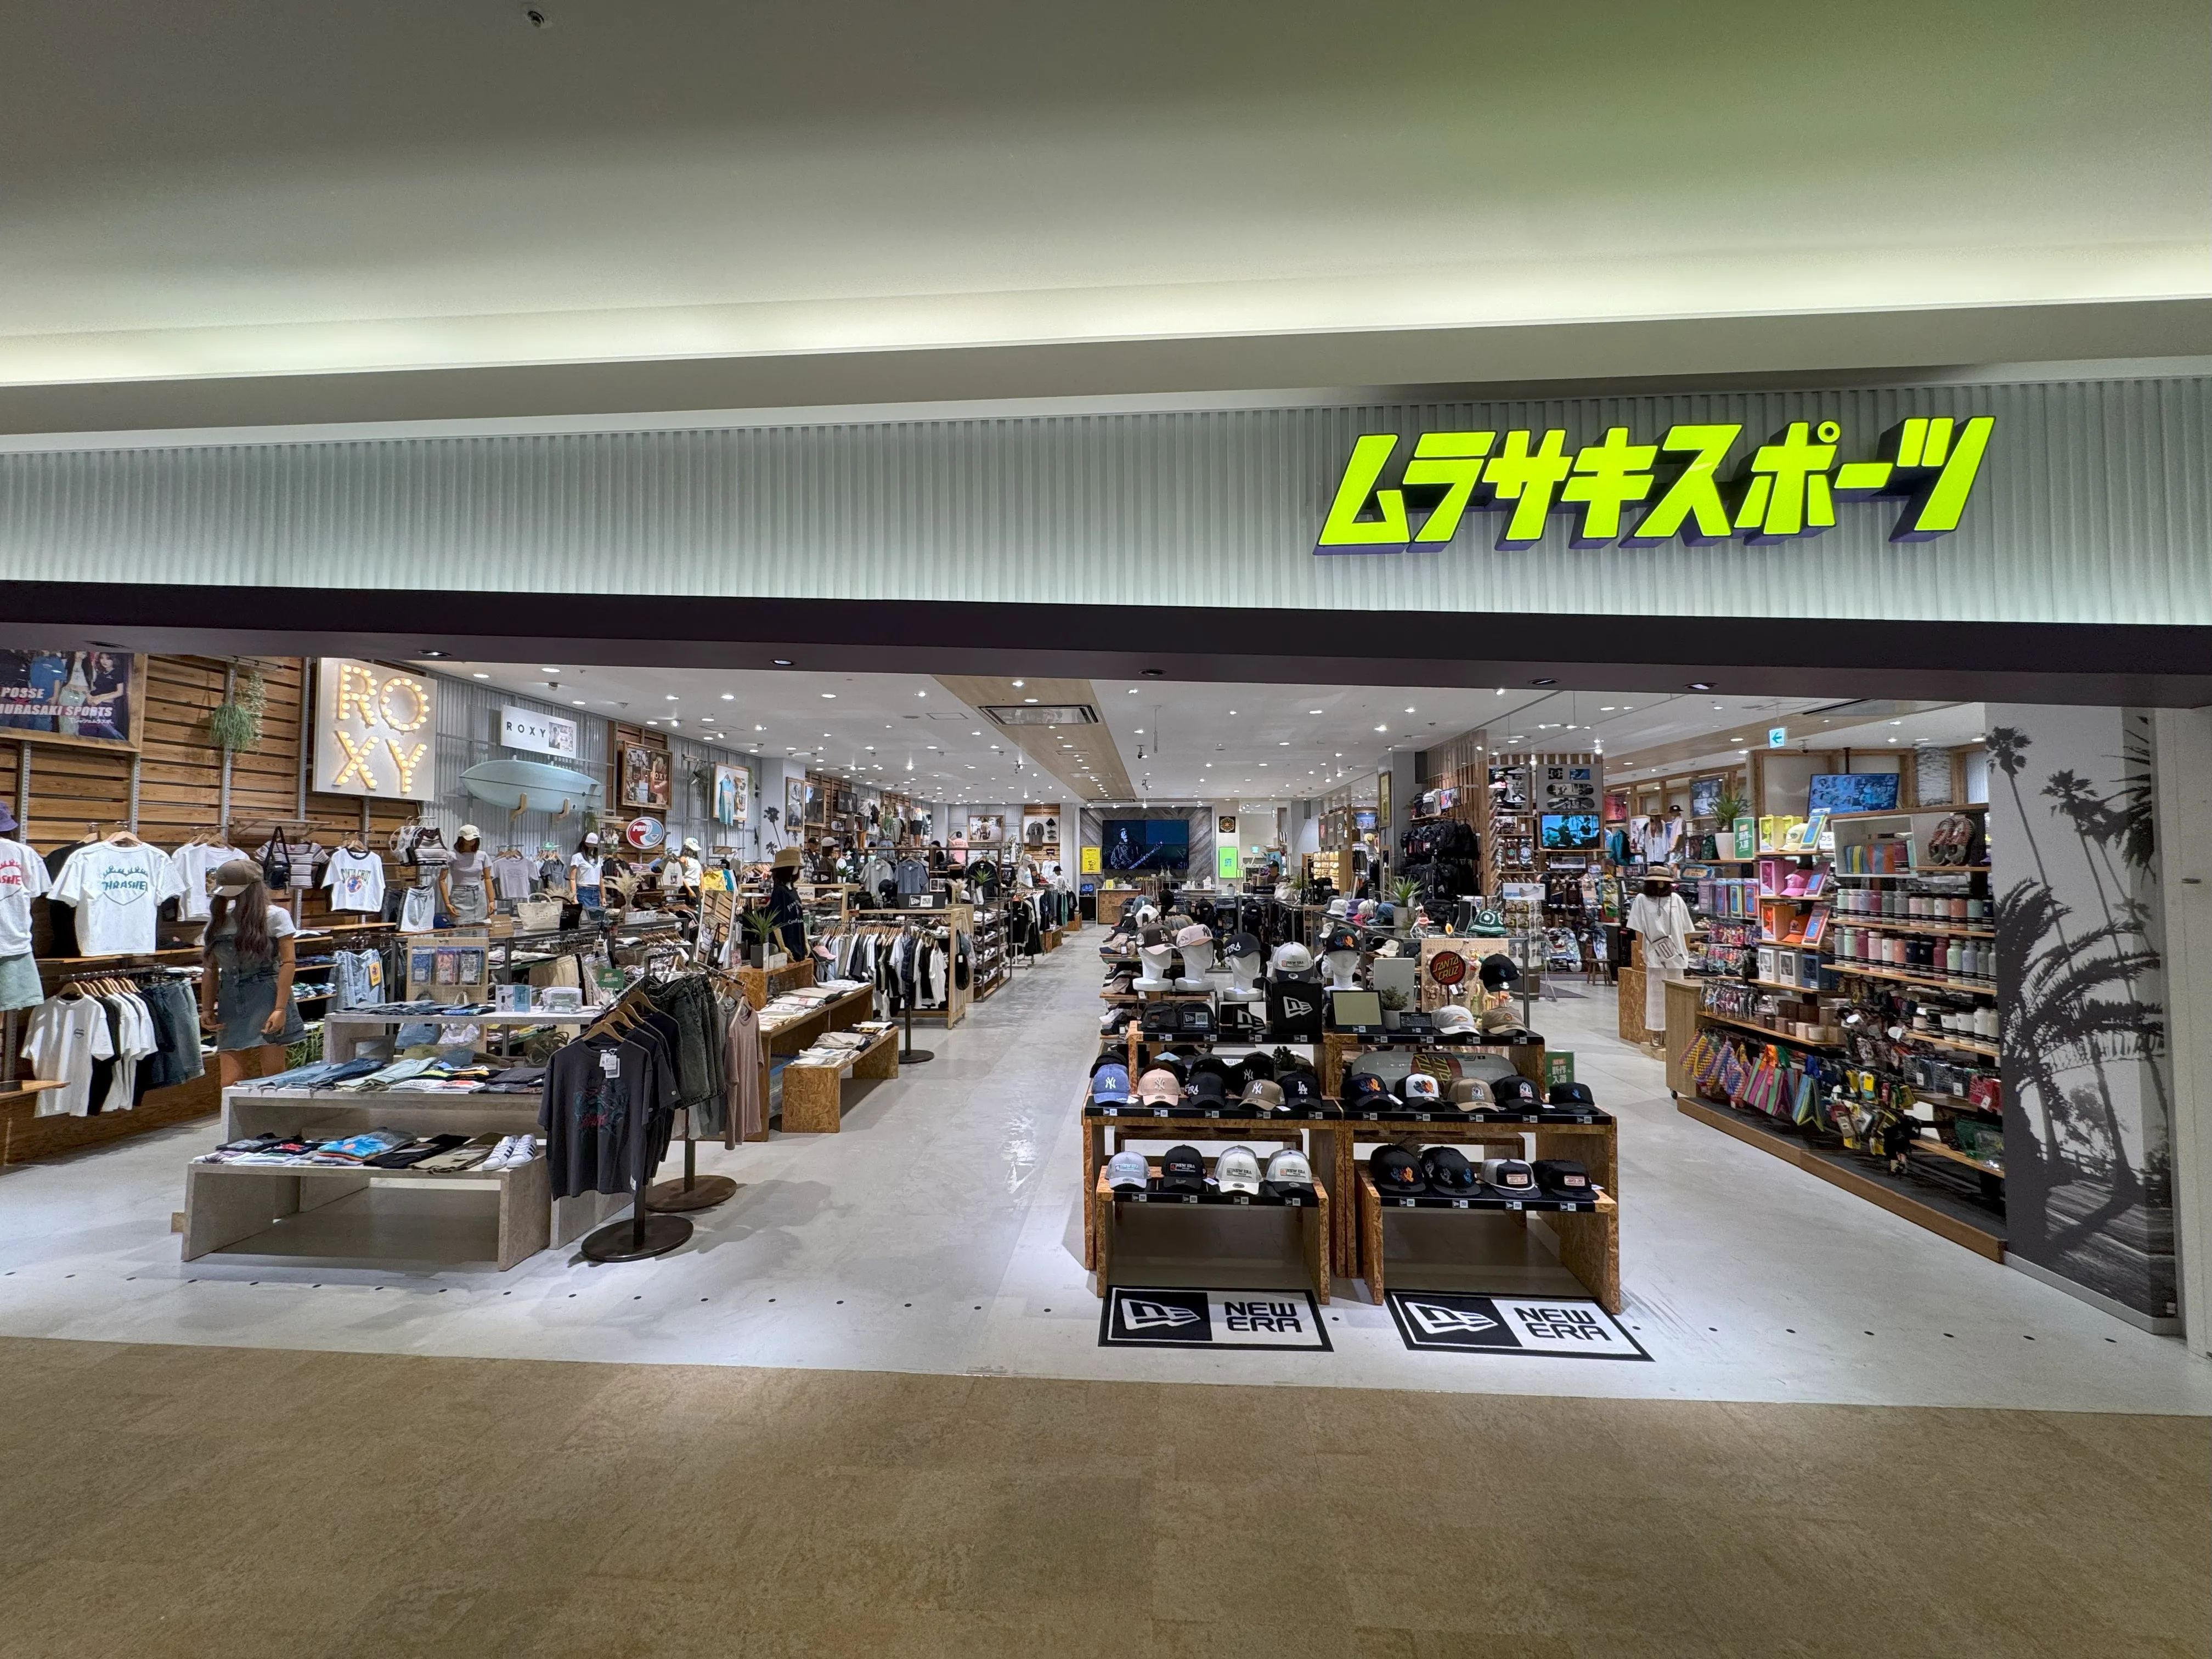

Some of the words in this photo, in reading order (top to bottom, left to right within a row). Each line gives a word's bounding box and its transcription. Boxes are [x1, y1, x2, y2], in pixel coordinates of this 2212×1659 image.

[1318, 415, 1996, 546] ムラサキスポーツ
[1, 687, 45, 698] POSSE
[65, 706, 113, 716] SPORTS
[506, 721, 546, 737] ROXY
[1159, 930, 1169, 941] LA
[1432, 955, 1459, 973] SANTA
[1438, 966, 1459, 981] CRUZ
[1105, 1076, 1116, 1089] NY
[1252, 1082, 1263, 1094] NY
[1297, 1081, 1308, 1094] LA
[1224, 1301, 1297, 1317] NEW
[1514, 1307, 1596, 1324] NEW
[1227, 1316, 1303, 1333] ERA
[1526, 1323, 1612, 1341] ERA
